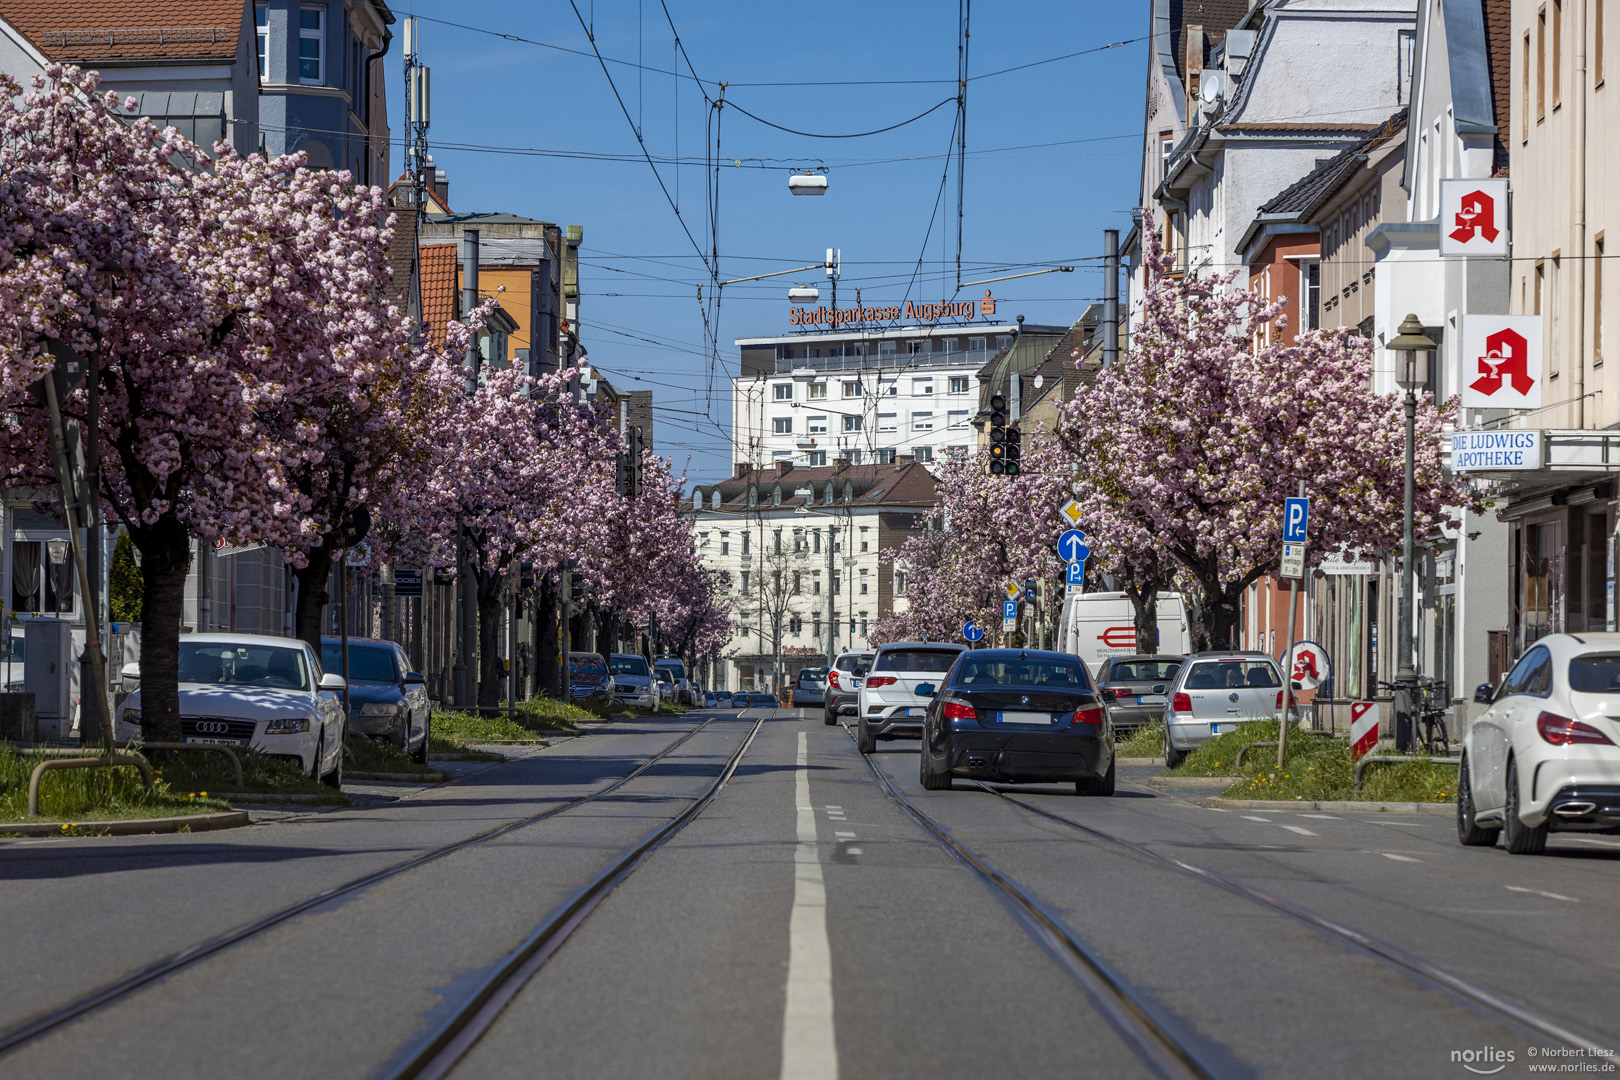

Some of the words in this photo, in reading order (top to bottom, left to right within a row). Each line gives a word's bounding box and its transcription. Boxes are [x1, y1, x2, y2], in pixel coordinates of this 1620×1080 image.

[789, 305, 900, 327] Stadtsparkasse
[905, 299, 975, 321] Augsburg
[1453, 435, 1468, 451] DIE
[1470, 433, 1534, 449] LUDWIGS
[1457, 451, 1523, 467] APOTHEKE
[1288, 503, 1303, 537] P
[1070, 563, 1080, 581] P
[1006, 603, 1014, 617] P
